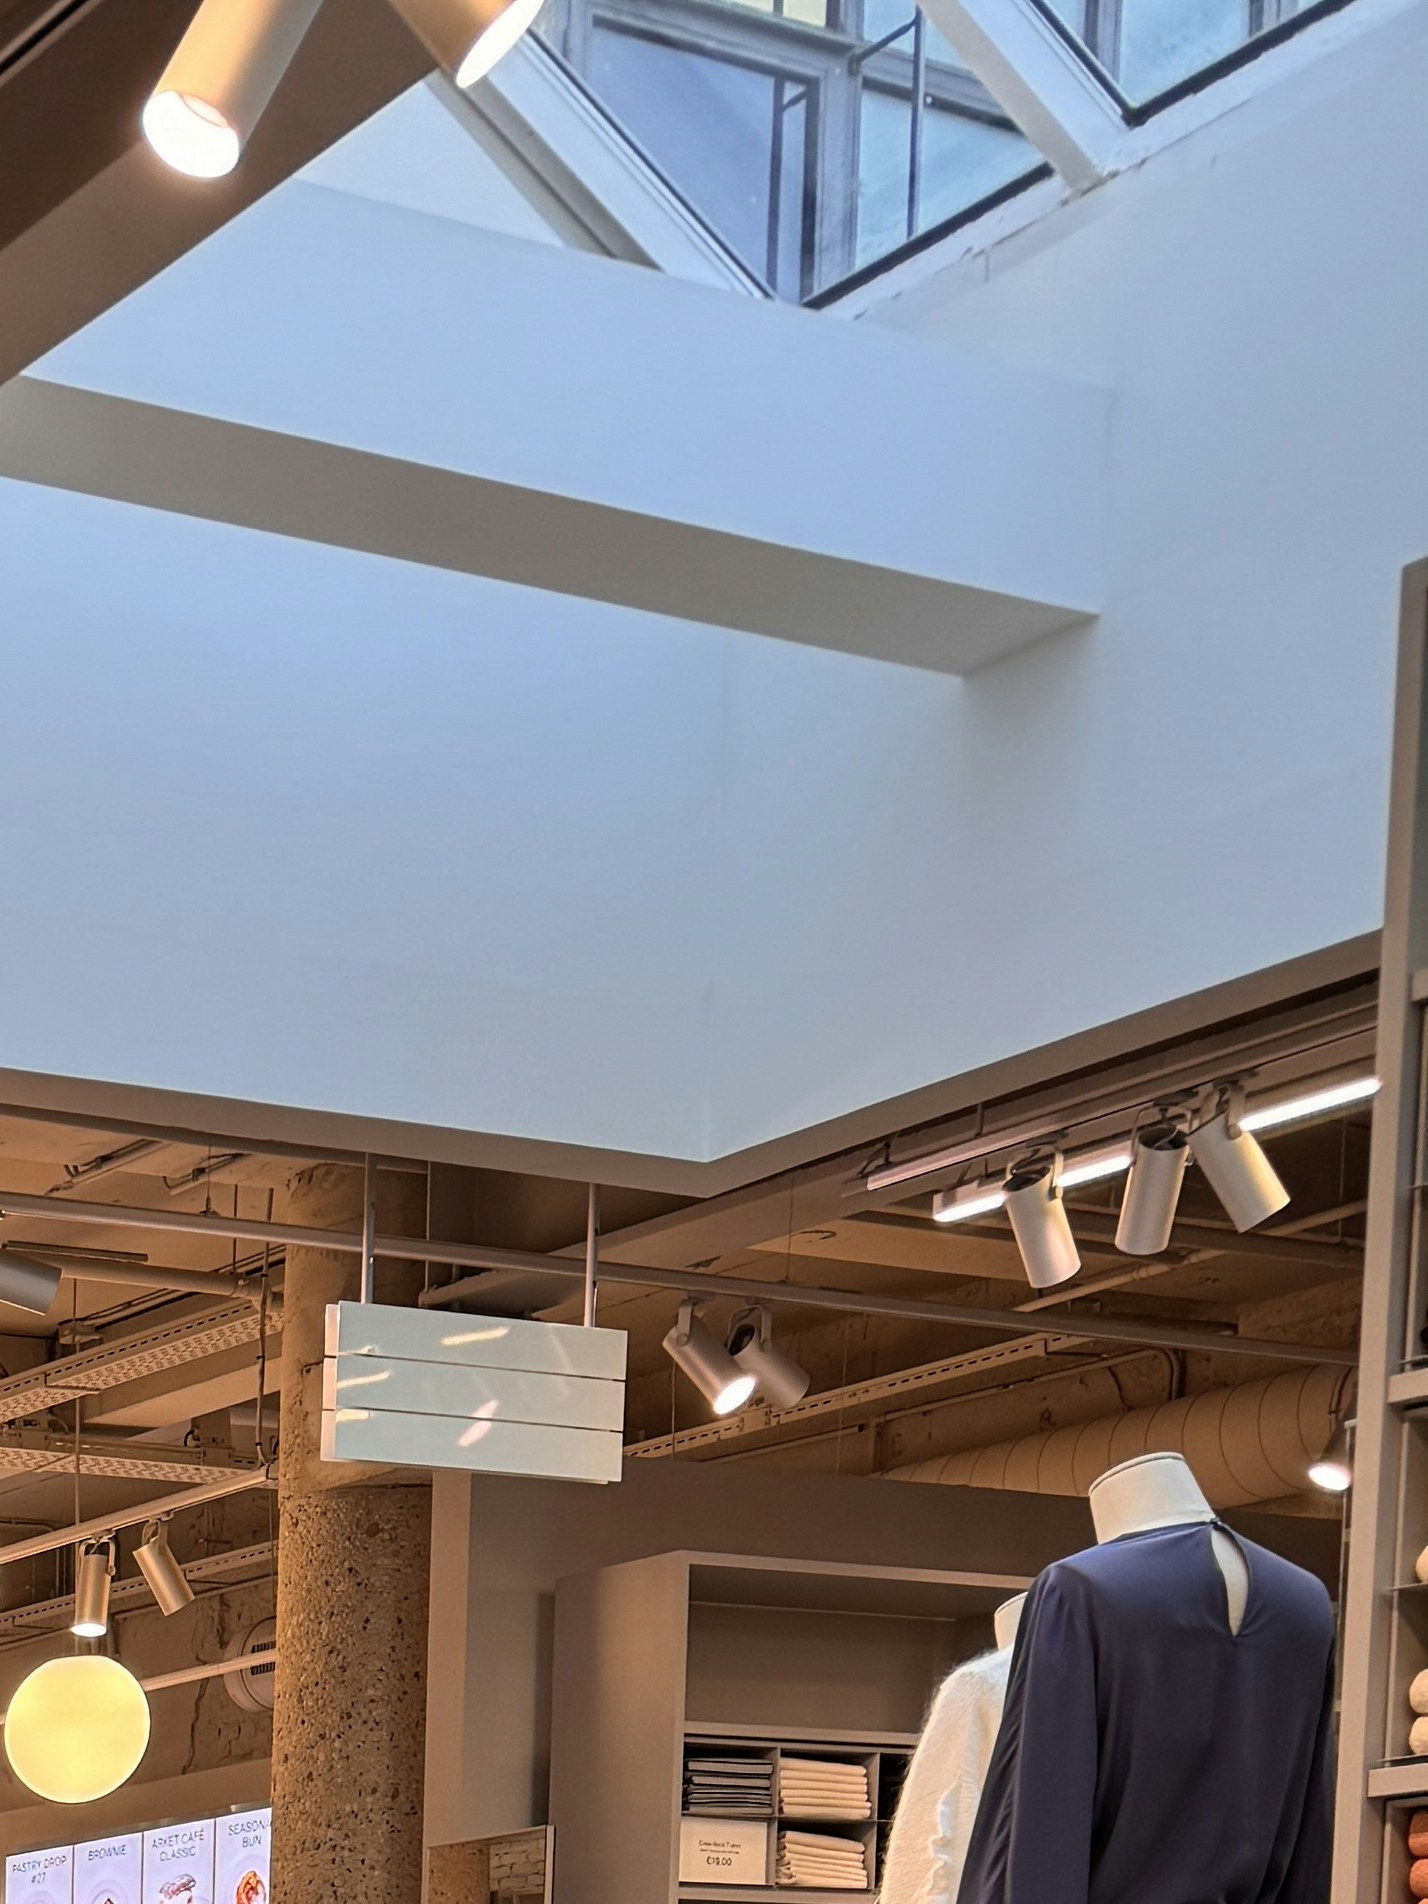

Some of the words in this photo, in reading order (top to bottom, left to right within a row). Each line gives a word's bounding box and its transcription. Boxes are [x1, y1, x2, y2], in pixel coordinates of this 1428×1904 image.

[242, 1835, 262, 1848] BUN
[88, 1844, 127, 1861] BROWNIE
[160, 1846, 196, 1862] CLASSIC
[12, 1860, 42, 1873] PASTRY
[44, 1855, 67, 1869] DROP
